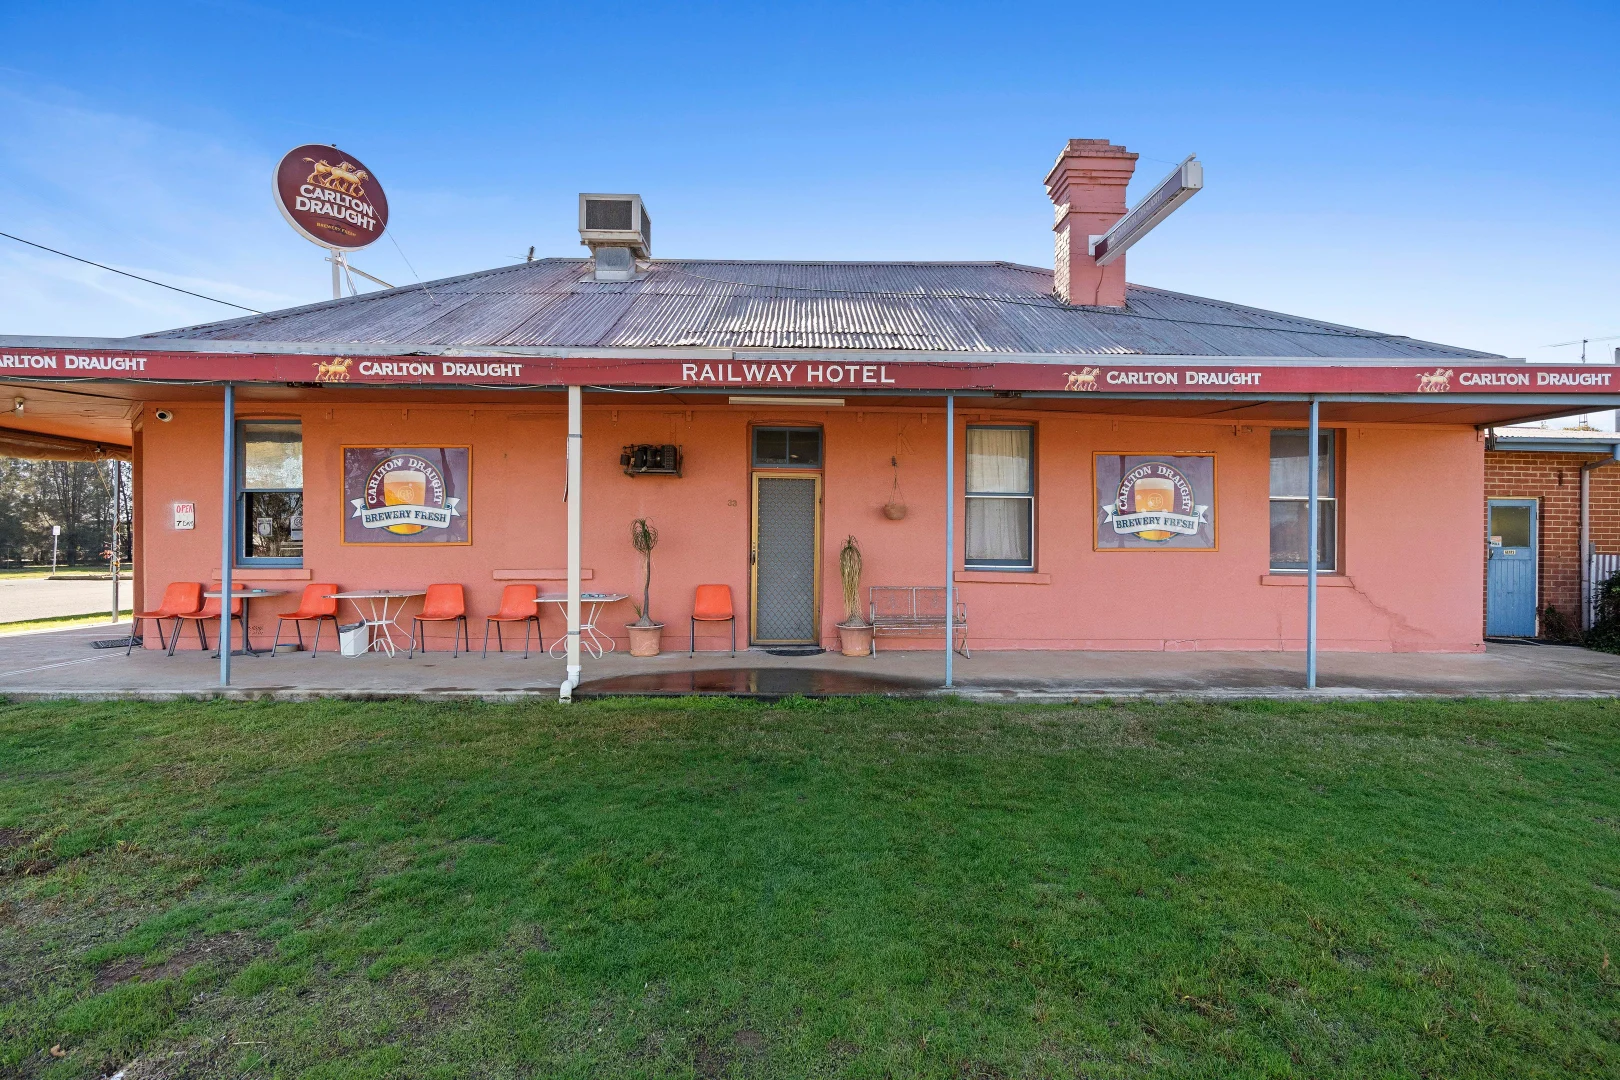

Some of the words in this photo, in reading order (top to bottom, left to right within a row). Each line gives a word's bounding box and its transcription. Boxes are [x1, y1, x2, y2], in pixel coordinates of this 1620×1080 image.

[300, 184, 373, 217] CARLTON
[295, 196, 376, 231] DRAUGHT
[65, 355, 147, 371] DRAUGHT
[359, 361, 435, 376] CARLTON
[442, 362, 522, 377] DRAUGHT
[682, 363, 797, 382] RAILWAY
[807, 365, 895, 384] HOTEL
[1106, 371, 1178, 385] CARLTON
[1185, 371, 1261, 385] DRAUGHT
[1459, 372, 1529, 386] CARLTON
[1537, 372, 1611, 386] DRAUGHT
[368, 458, 404, 504] CARLTON
[408, 458, 443, 504] DRAUGHT
[1118, 465, 1152, 510] CARLTON
[1157, 465, 1191, 512] DRAUGHT
[176, 504, 193, 513] OPEN
[365, 510, 411, 523] BREWERY
[415, 510, 446, 523] FRESH
[1116, 516, 1161, 529] BREWERY
[1164, 517, 1195, 530] FRESH
